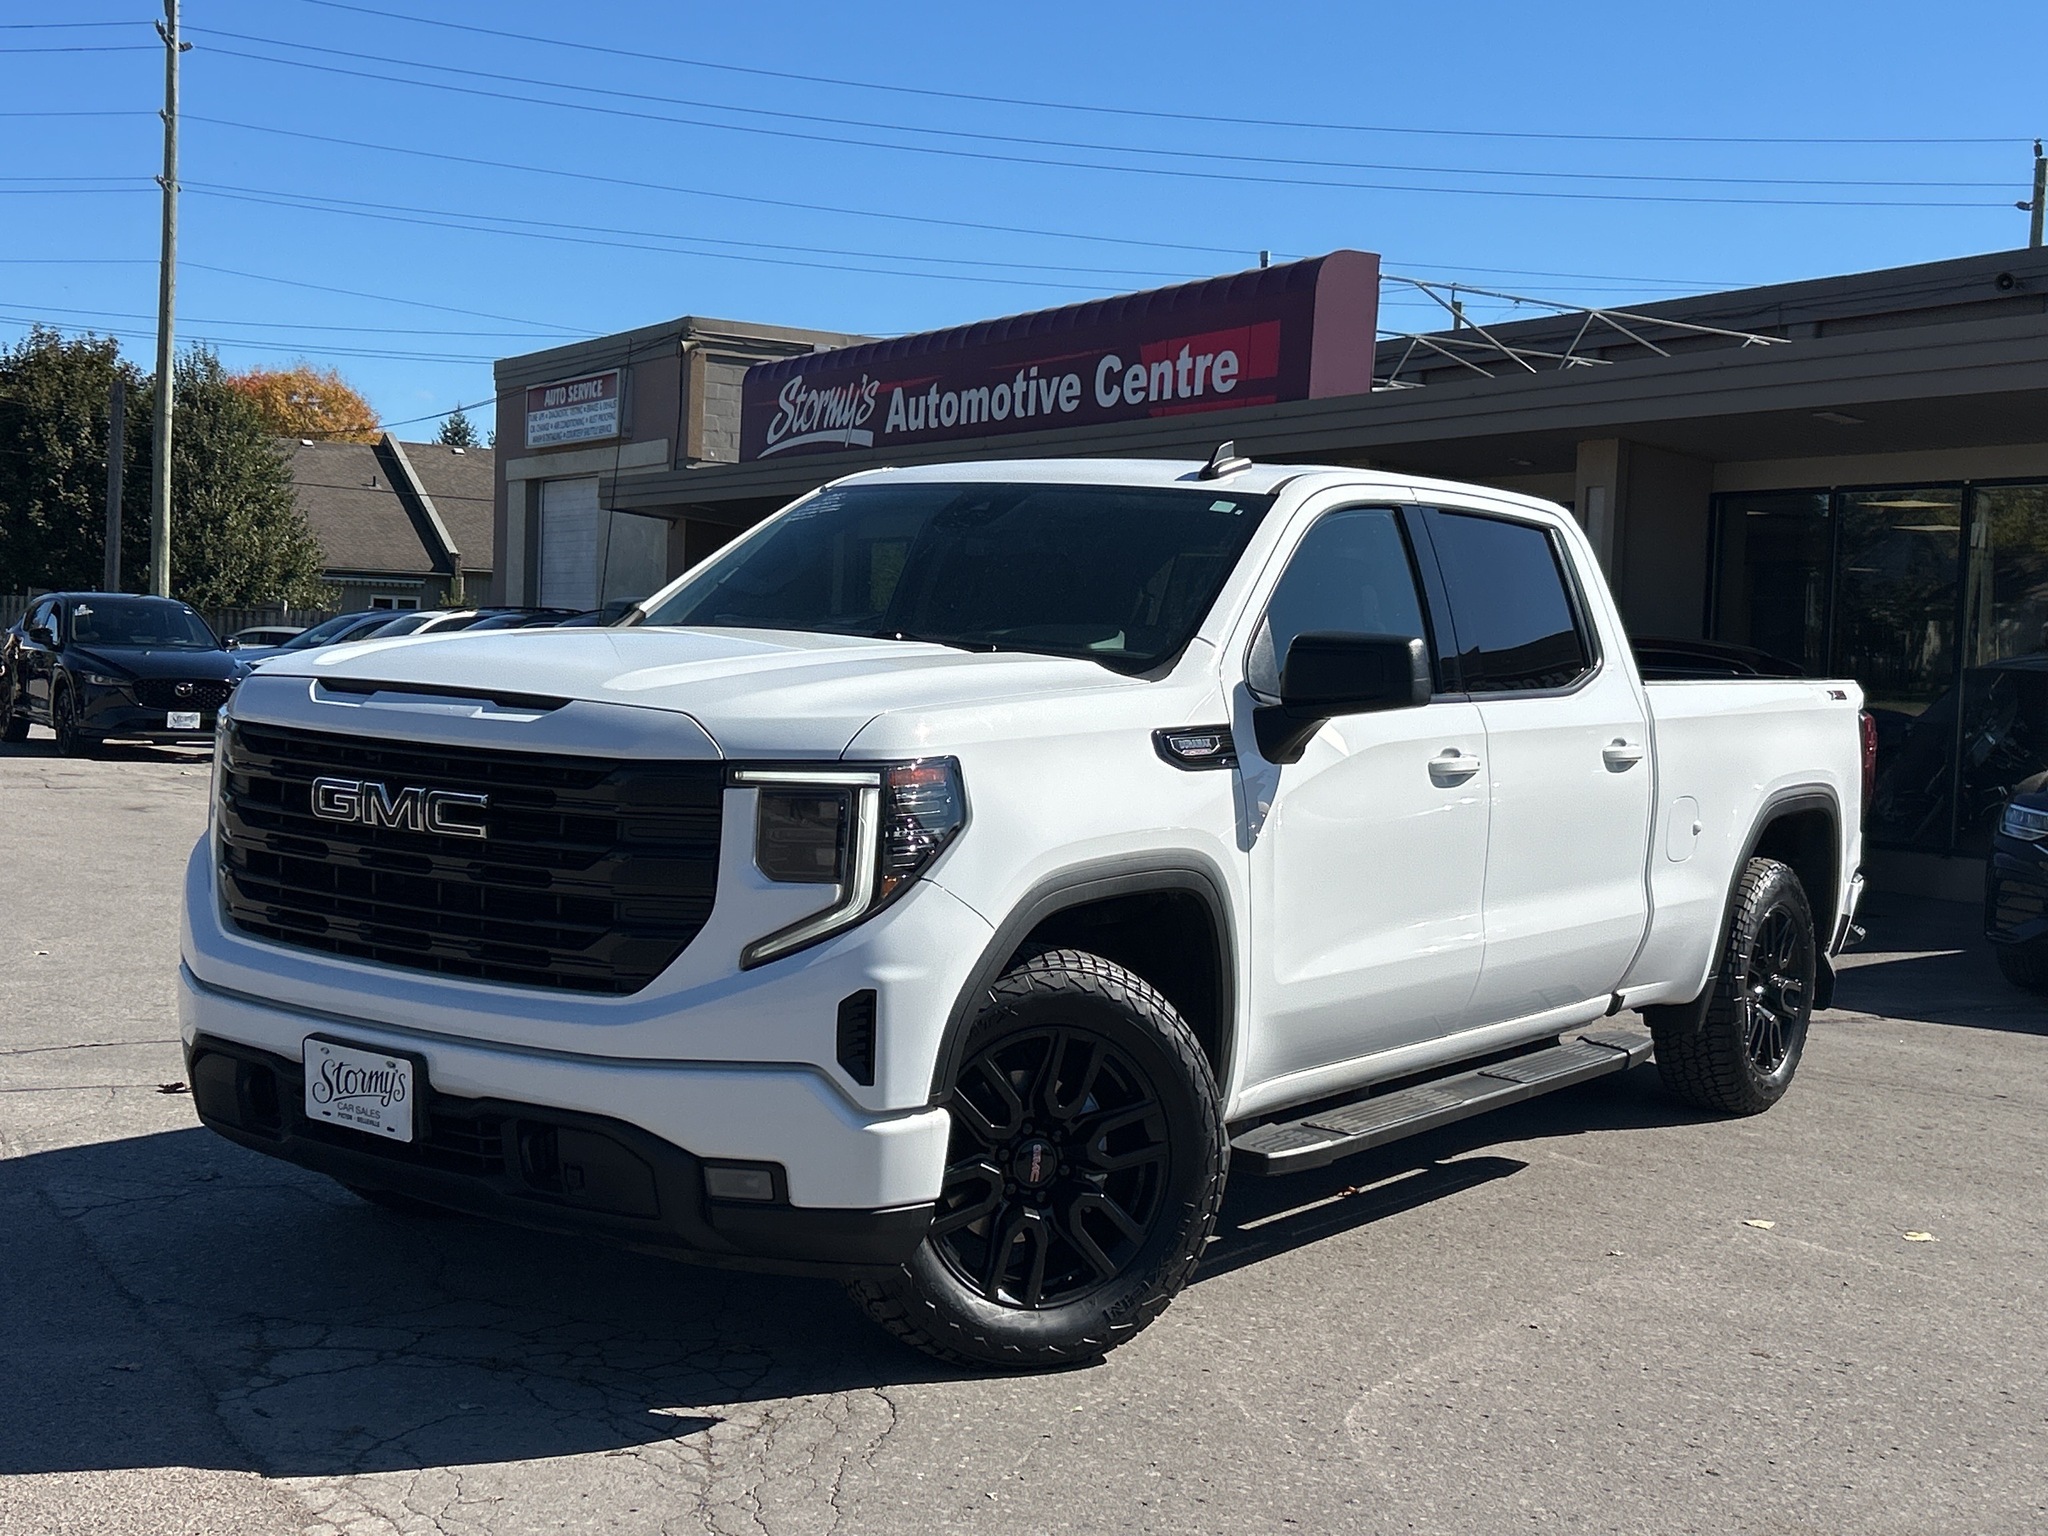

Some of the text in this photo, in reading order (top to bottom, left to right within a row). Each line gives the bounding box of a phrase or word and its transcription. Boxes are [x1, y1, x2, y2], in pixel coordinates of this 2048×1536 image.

[544, 380, 603, 407] AUTO SERVICE
[767, 344, 1239, 448] Stormy's Automotive Centre
[311, 776, 488, 839] GMC
[312, 1059, 406, 1108] Stormy's
[337, 1102, 381, 1119] CAR SALES
[1029, 1143, 1042, 1183] GMC
